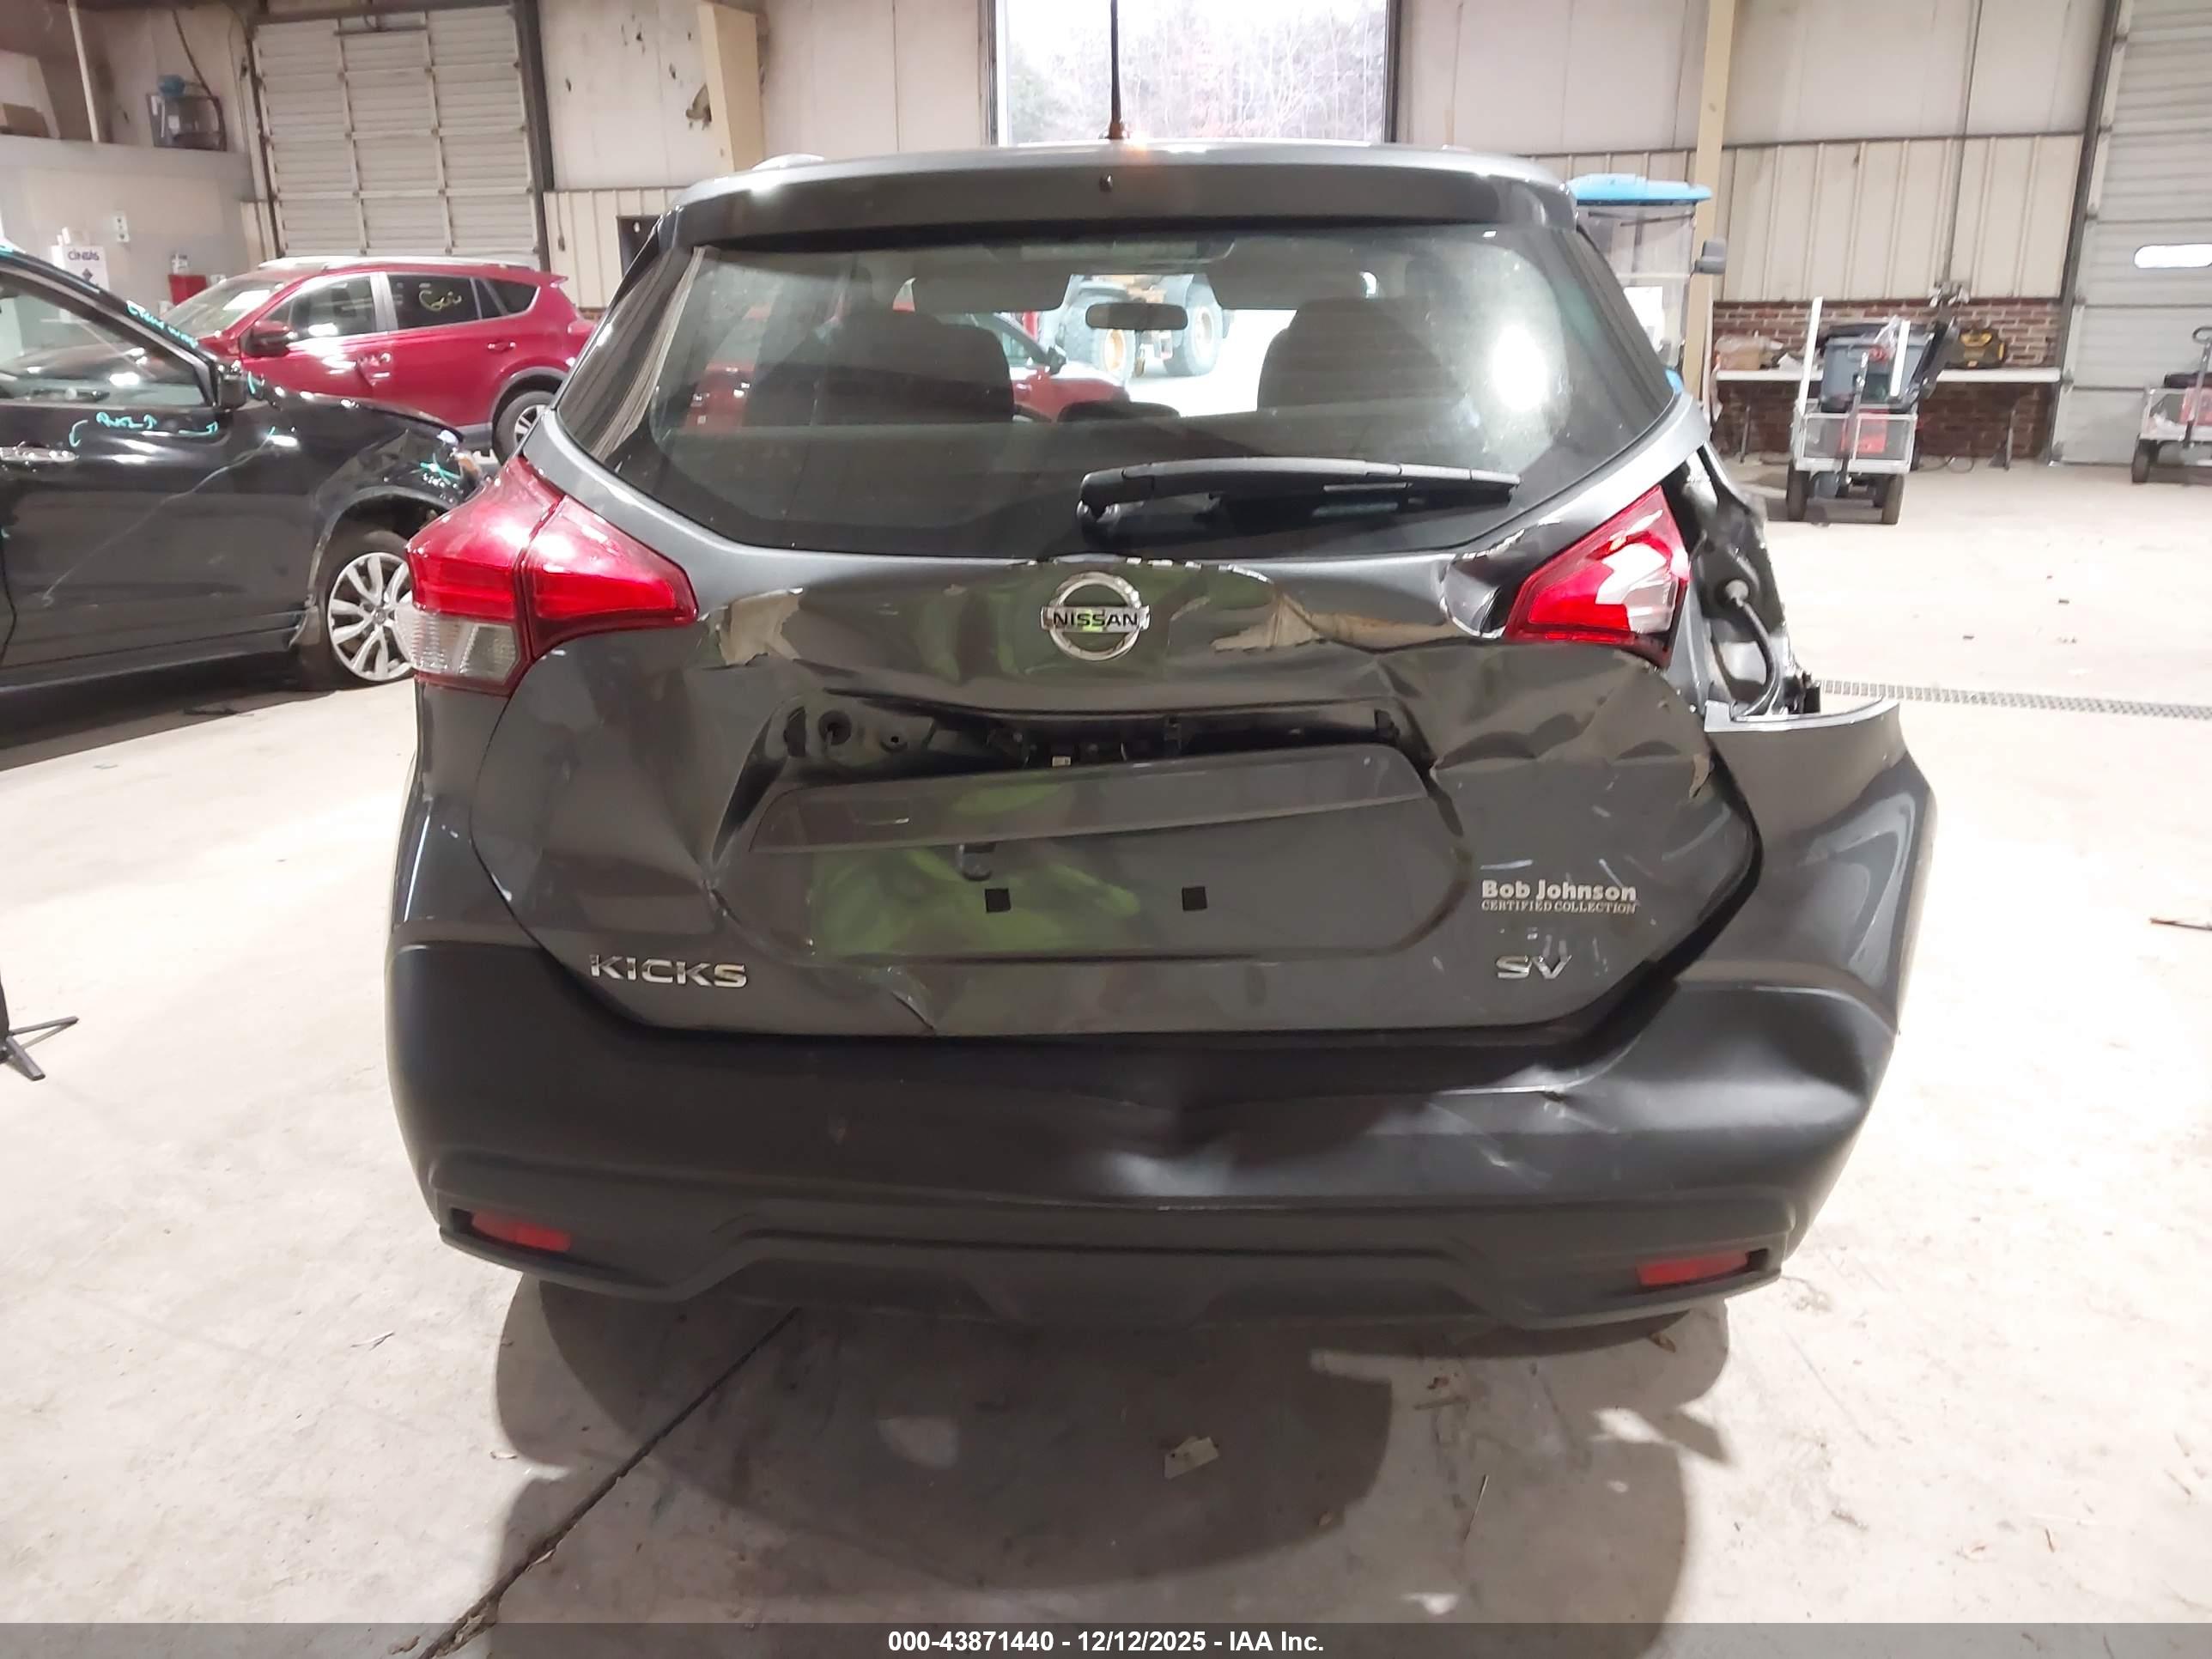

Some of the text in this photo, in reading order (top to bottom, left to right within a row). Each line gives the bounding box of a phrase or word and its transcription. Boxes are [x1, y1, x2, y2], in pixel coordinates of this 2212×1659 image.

[1053, 612, 1138, 626] NISSAN
[1481, 879, 1637, 901] Bob Johnson
[1481, 900, 1637, 915] CERTIFIED COLLECTION
[589, 954, 748, 988] KICKS
[1495, 955, 1573, 979] SV
